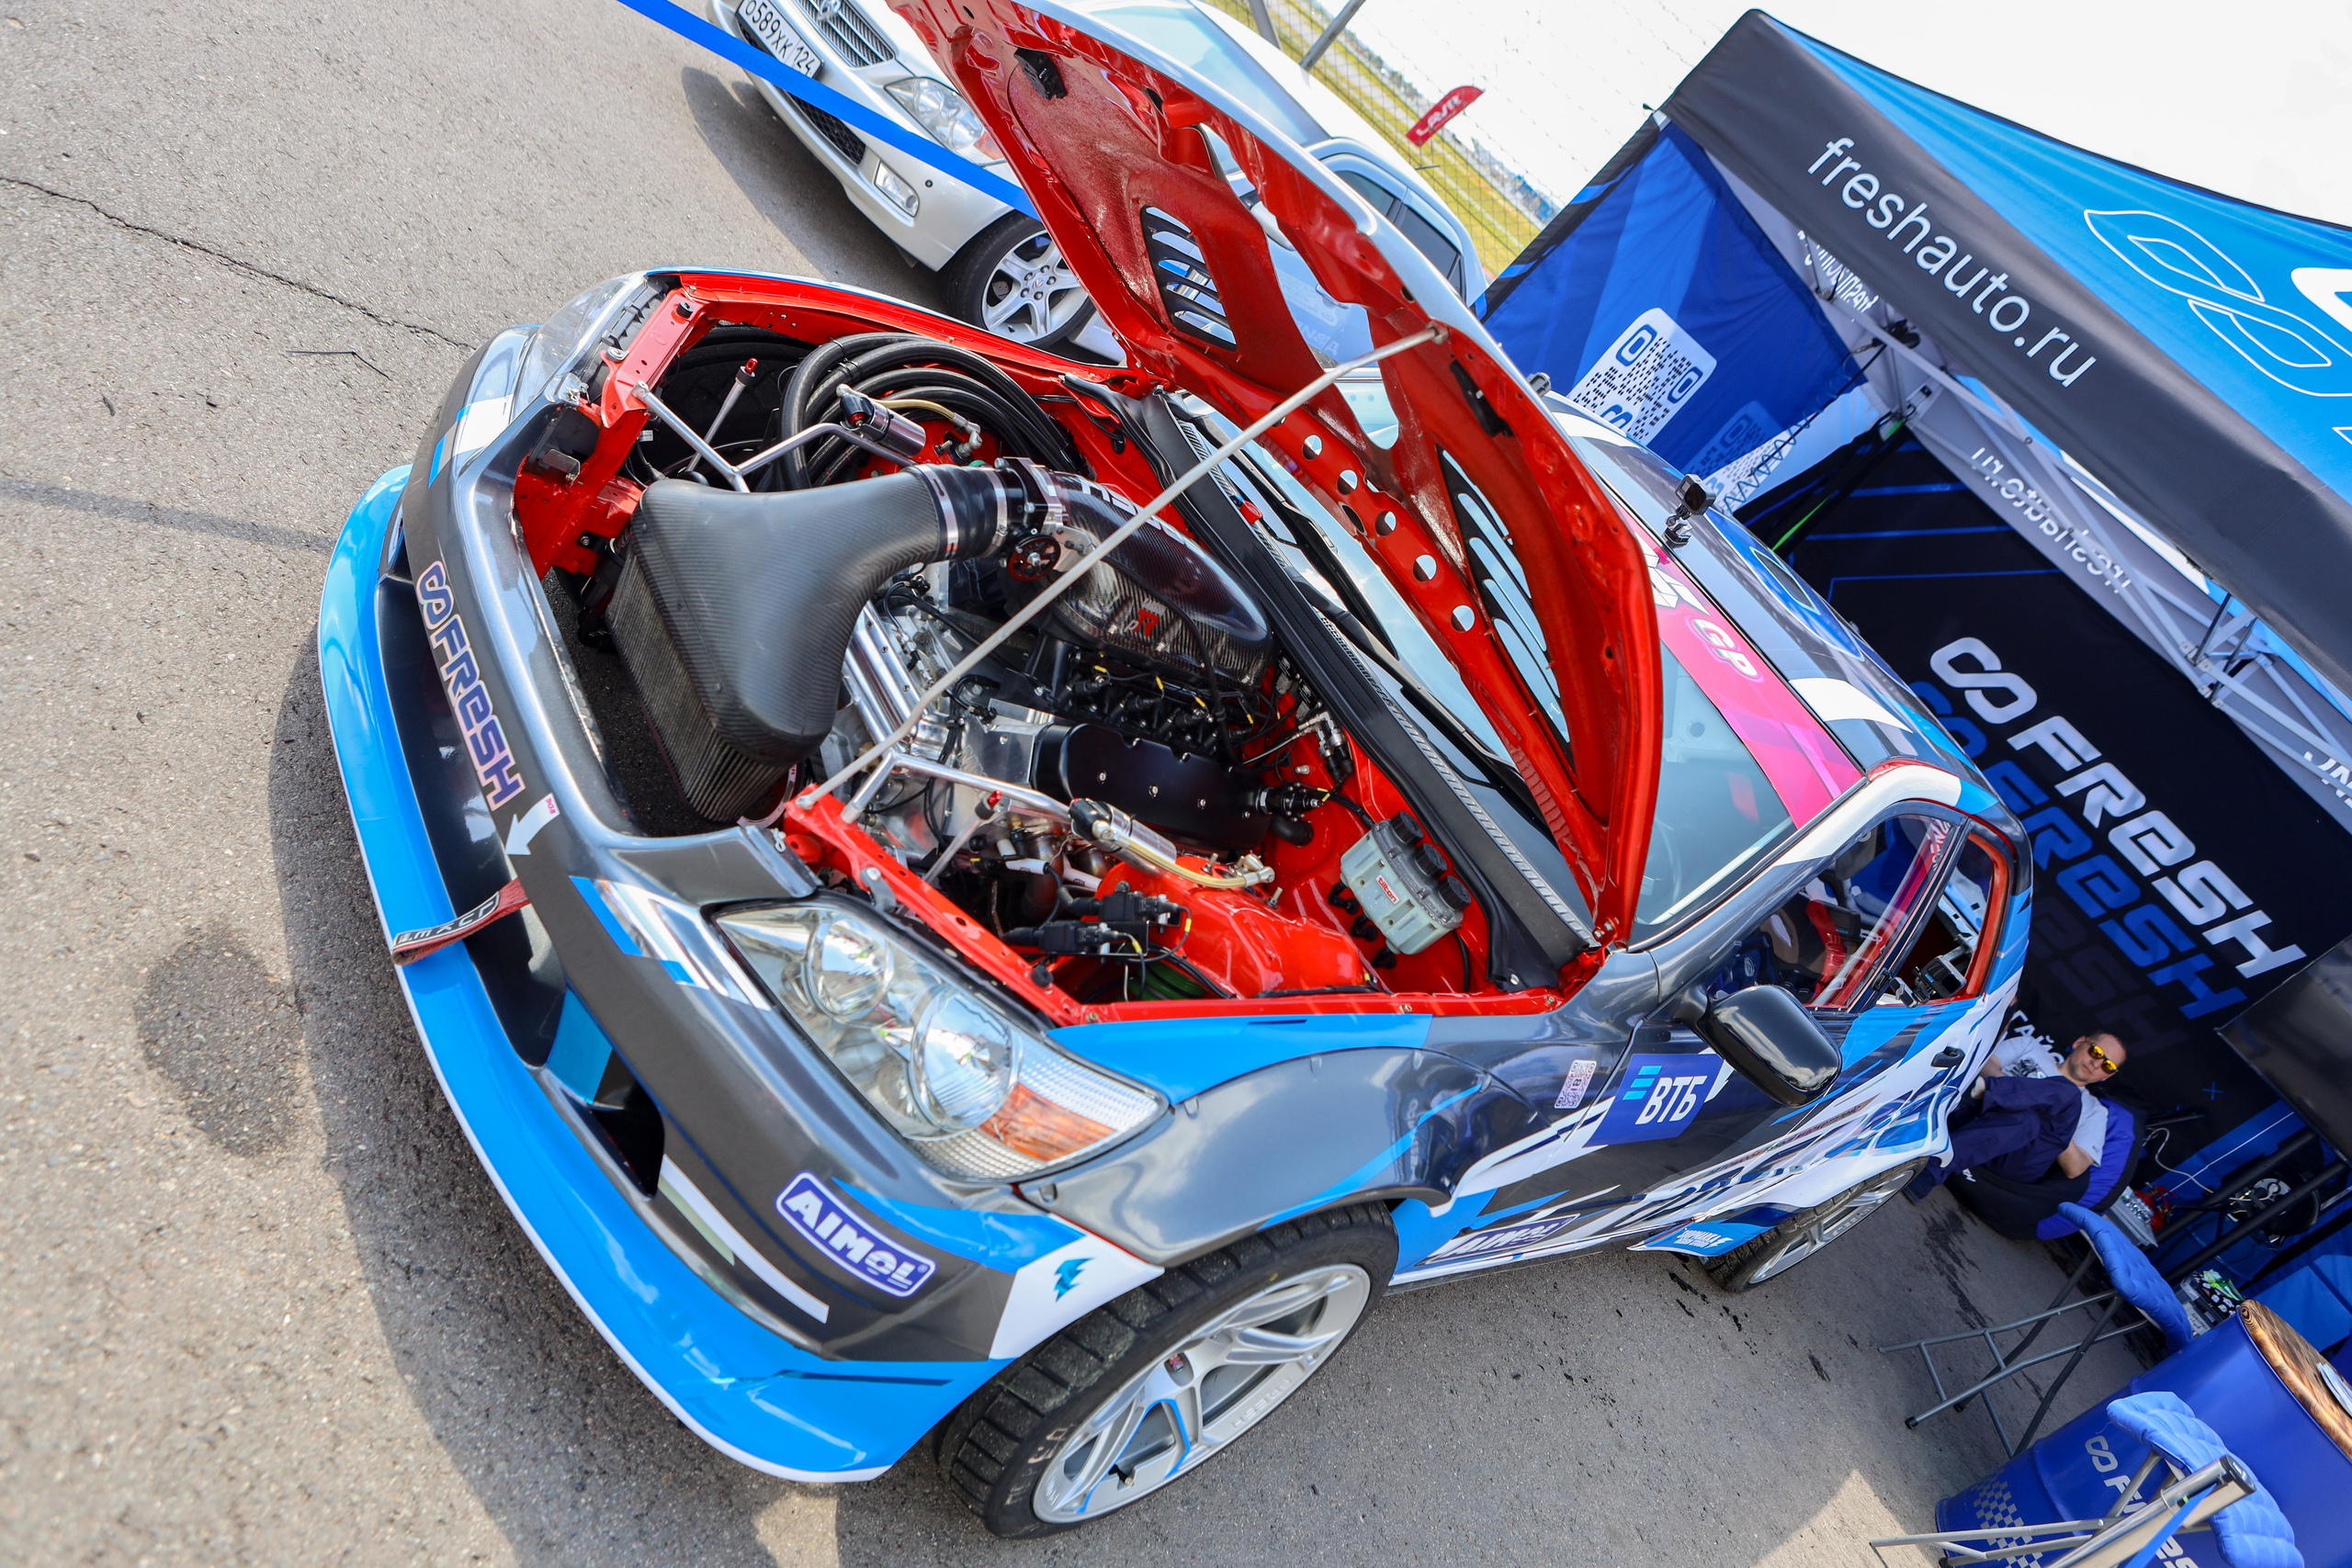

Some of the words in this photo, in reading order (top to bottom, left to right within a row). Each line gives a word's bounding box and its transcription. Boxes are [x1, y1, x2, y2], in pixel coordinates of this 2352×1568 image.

[1807, 137, 2098, 389] freshauto.ru
[1691, 617, 1758, 678] GP
[1378, 876, 1397, 903] tilton
[1634, 1075, 1708, 1125] ВТБ
[785, 1189, 917, 1290] AIMOL
